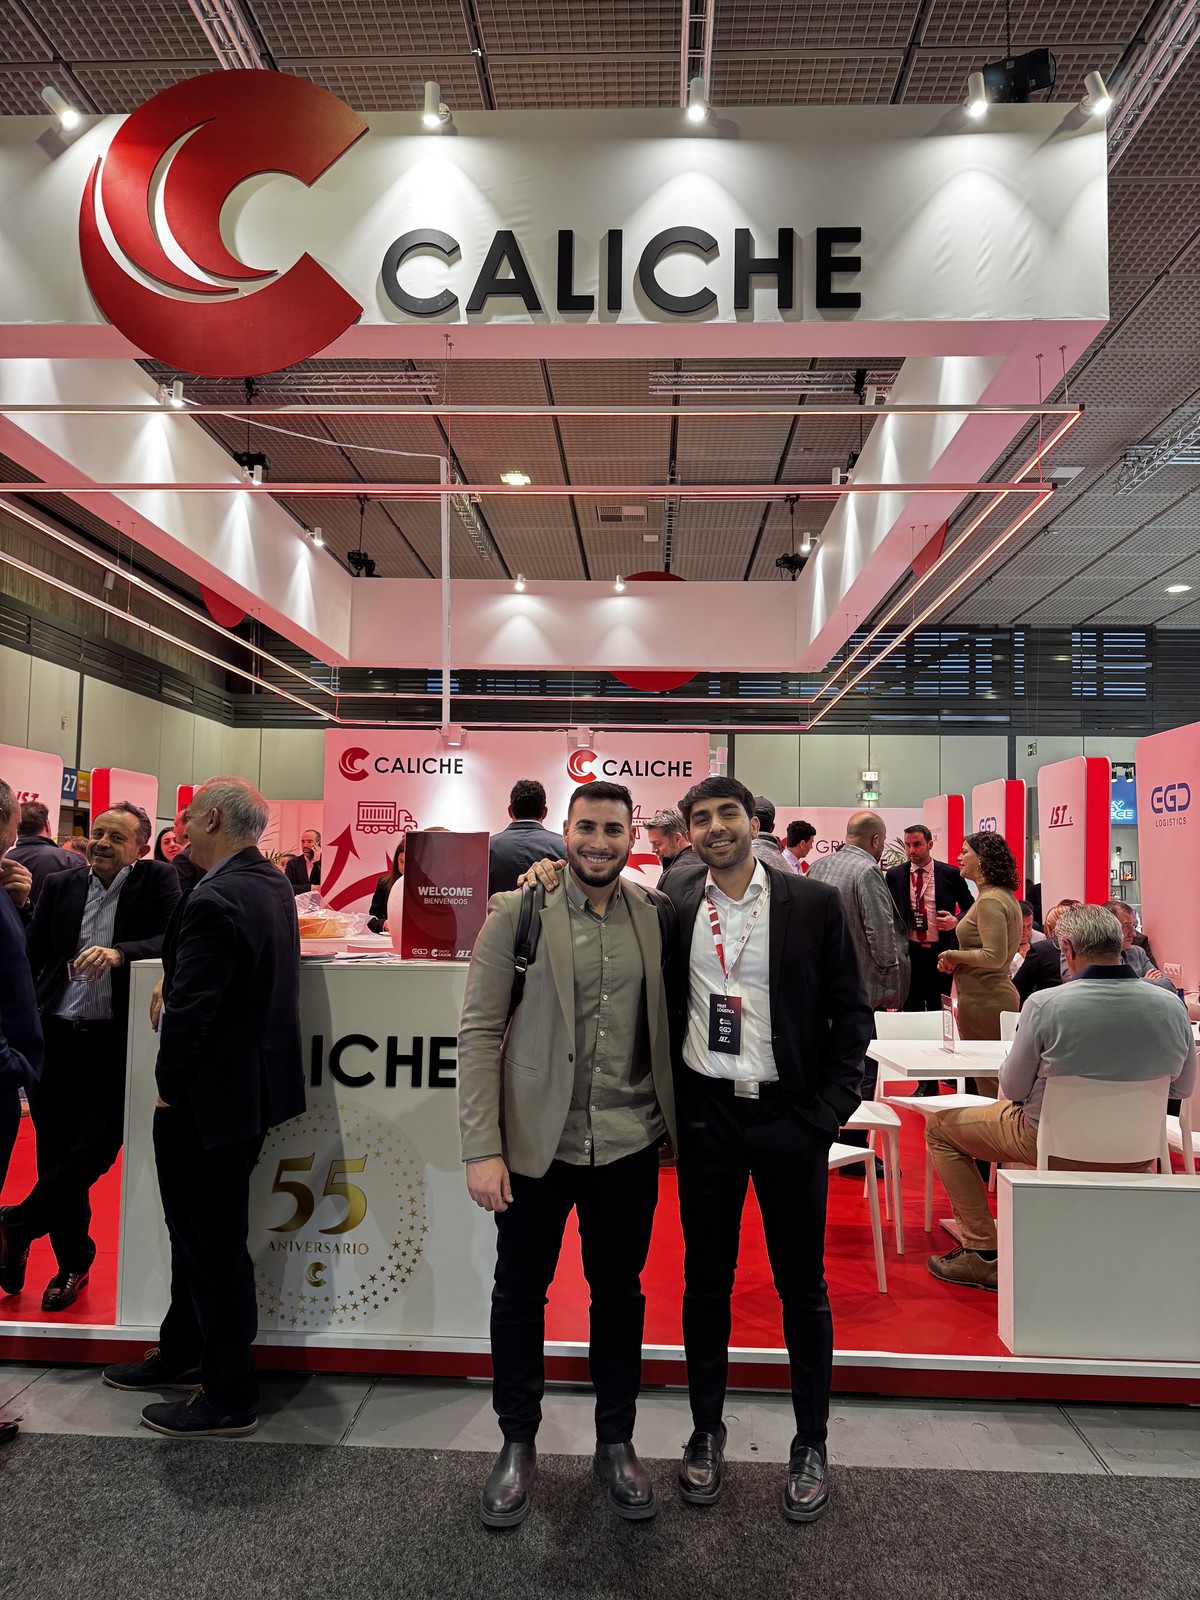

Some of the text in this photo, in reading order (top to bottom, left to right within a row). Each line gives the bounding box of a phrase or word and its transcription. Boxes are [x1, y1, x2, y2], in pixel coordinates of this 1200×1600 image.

[380, 225, 862, 316] CALICHE
[373, 756, 464, 775] CALICHE
[601, 759, 693, 778] CALICHE
[63, 773, 77, 793] 27
[1150, 782, 1191, 815] EGD
[1155, 817, 1187, 828] LOGISTICS
[815, 840, 847, 853] GR
[417, 886, 474, 897] WELCOME
[423, 897, 469, 905] BIENVENIDOS
[305, 1033, 458, 1088] ICHE
[266, 1152, 369, 1235] 55
[267, 1240, 370, 1255] ANIVERSARIO
